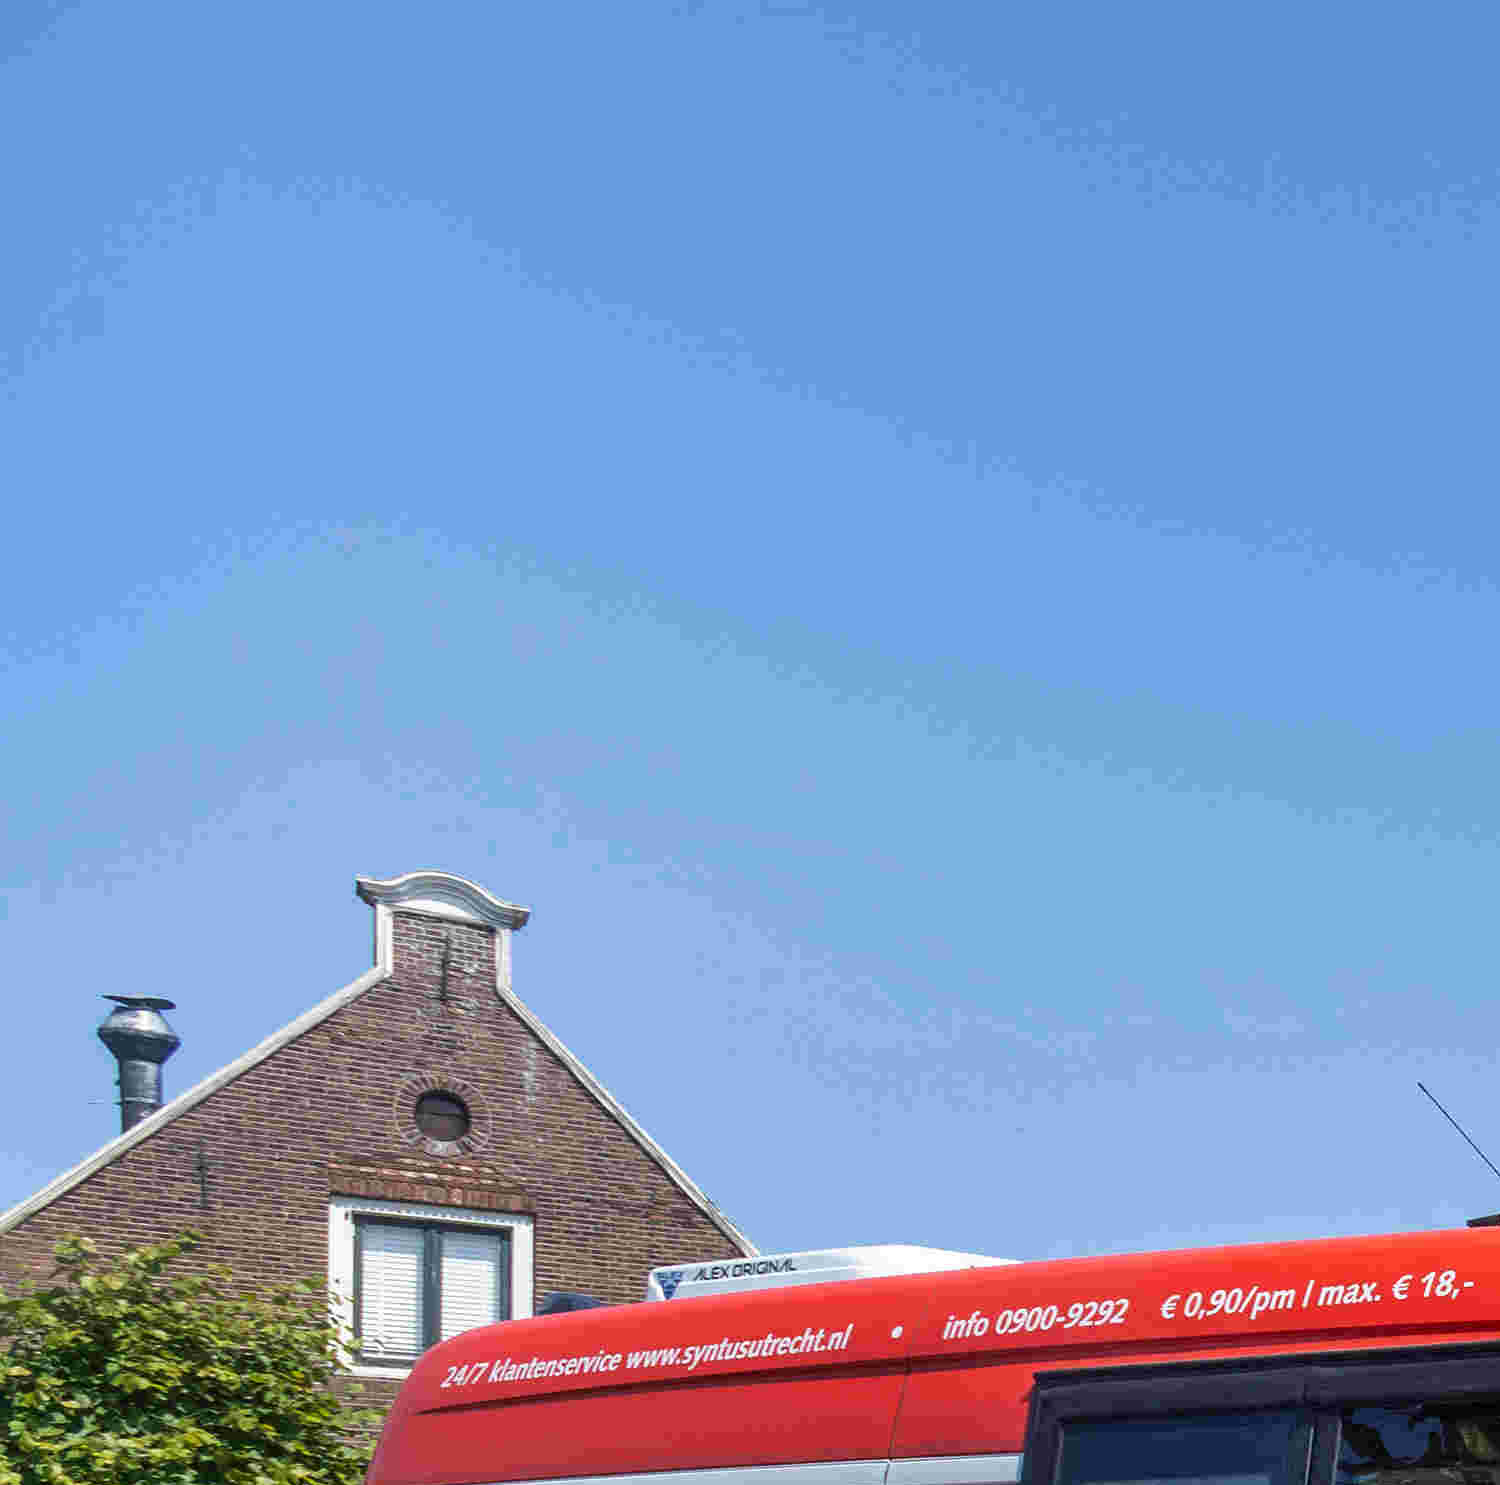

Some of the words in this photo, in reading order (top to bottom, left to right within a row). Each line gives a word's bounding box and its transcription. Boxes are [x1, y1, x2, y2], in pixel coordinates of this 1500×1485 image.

[731, 1257, 798, 1277] ORIGINAL
[1183, 1286, 1297, 1320] 0,90/pm
[1317, 1281, 1382, 1306] max.
[1421, 1269, 1475, 1299] 18,-
[943, 1310, 988, 1341] info
[995, 1298, 1129, 1334] 0900-9292
[439, 1364, 487, 1389] 24/7
[488, 1350, 622, 1384] klantenservice
[625, 1324, 854, 1371] www.syntusutrecht.nl
